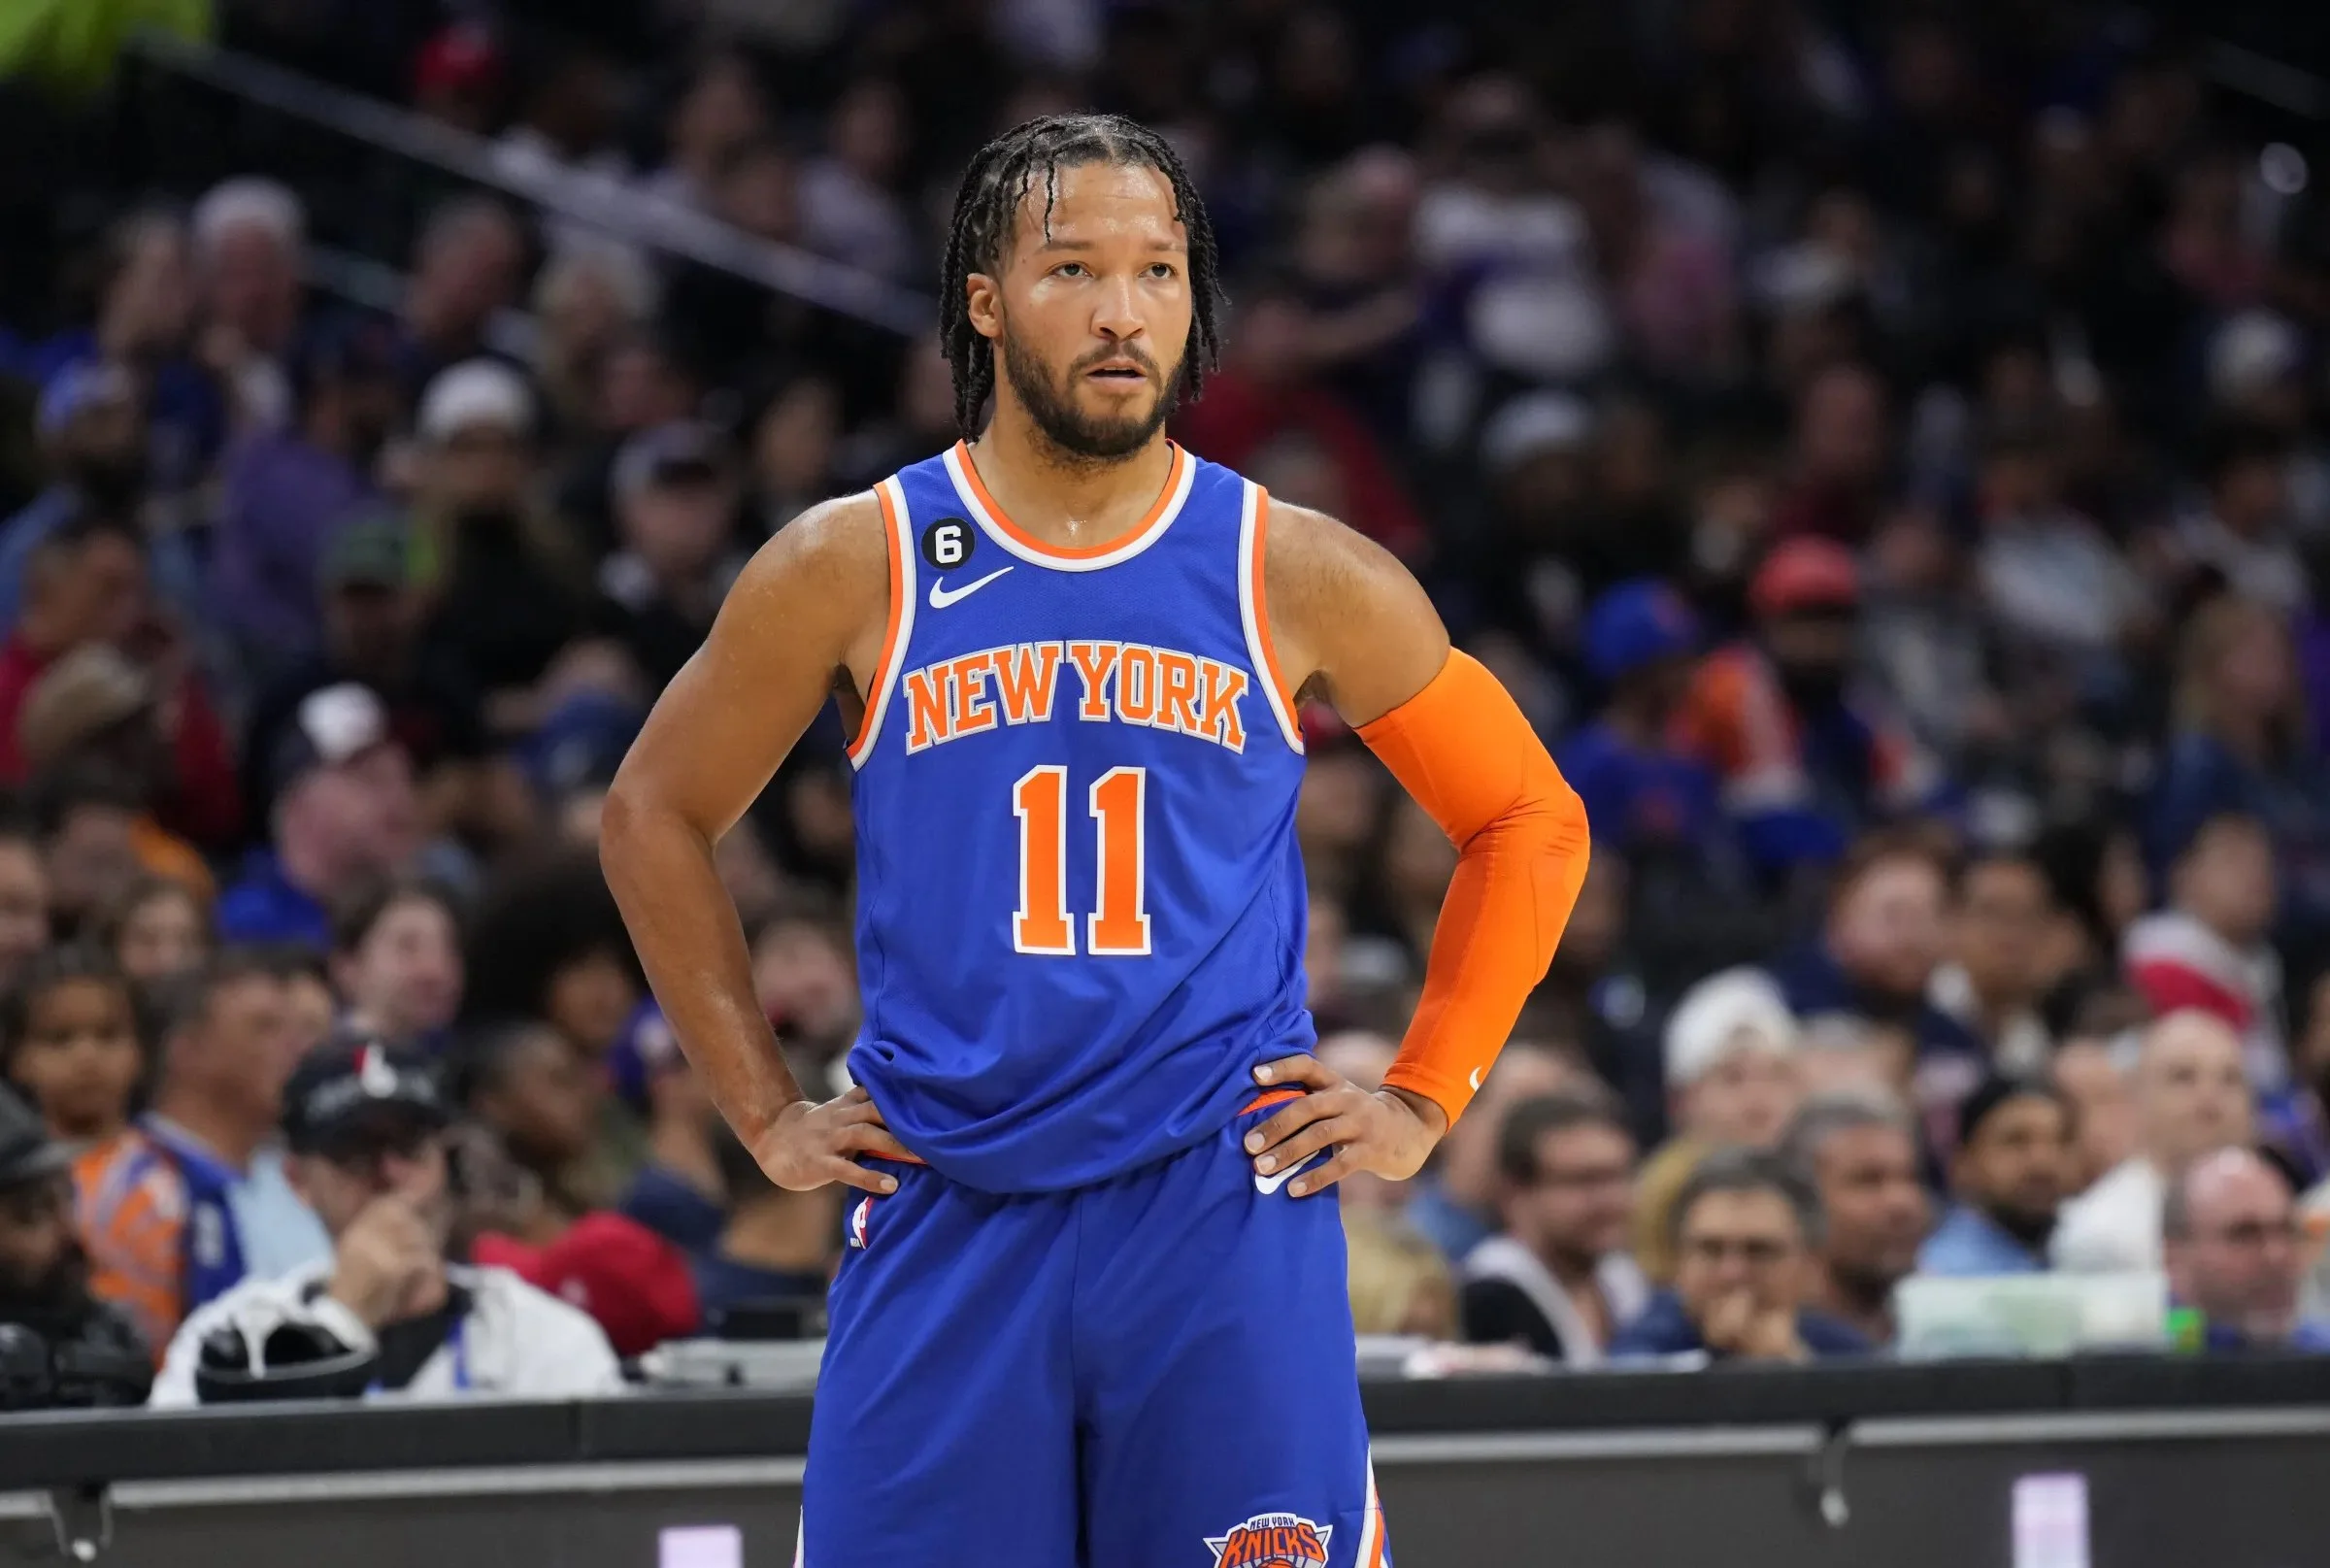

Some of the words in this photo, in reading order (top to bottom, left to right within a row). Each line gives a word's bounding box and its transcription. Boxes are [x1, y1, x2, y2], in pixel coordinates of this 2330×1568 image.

[935, 525, 962, 563] 6
[903, 640, 1065, 755] NEW
[1065, 640, 1249, 755] YORK
[1013, 764, 1152, 955] 11
[1220, 1522, 1326, 1568] KNICKS
[1249, 1518, 1270, 1531] NEW
[1271, 1516, 1295, 1528] YORK
